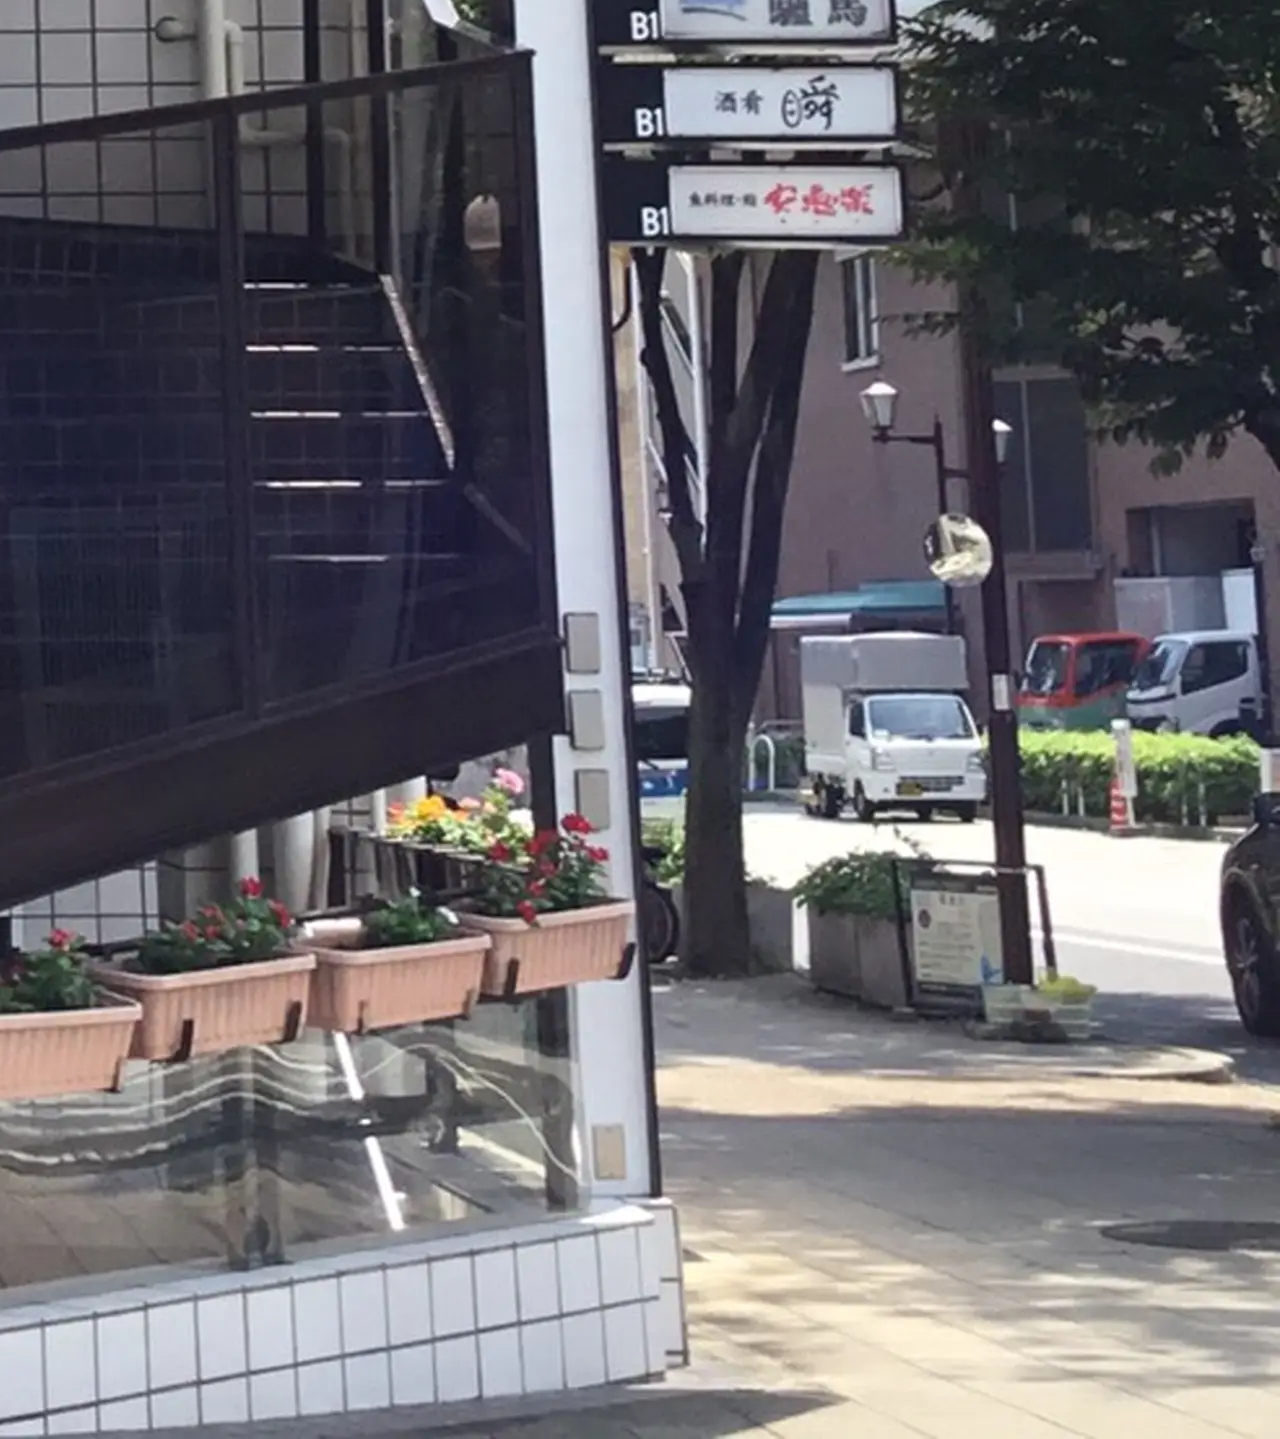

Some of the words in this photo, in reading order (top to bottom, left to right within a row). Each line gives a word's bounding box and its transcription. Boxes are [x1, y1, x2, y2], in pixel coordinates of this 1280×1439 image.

[631, 12, 659, 40] B1
[635, 109, 664, 136] B1
[642, 207, 670, 236] B1
